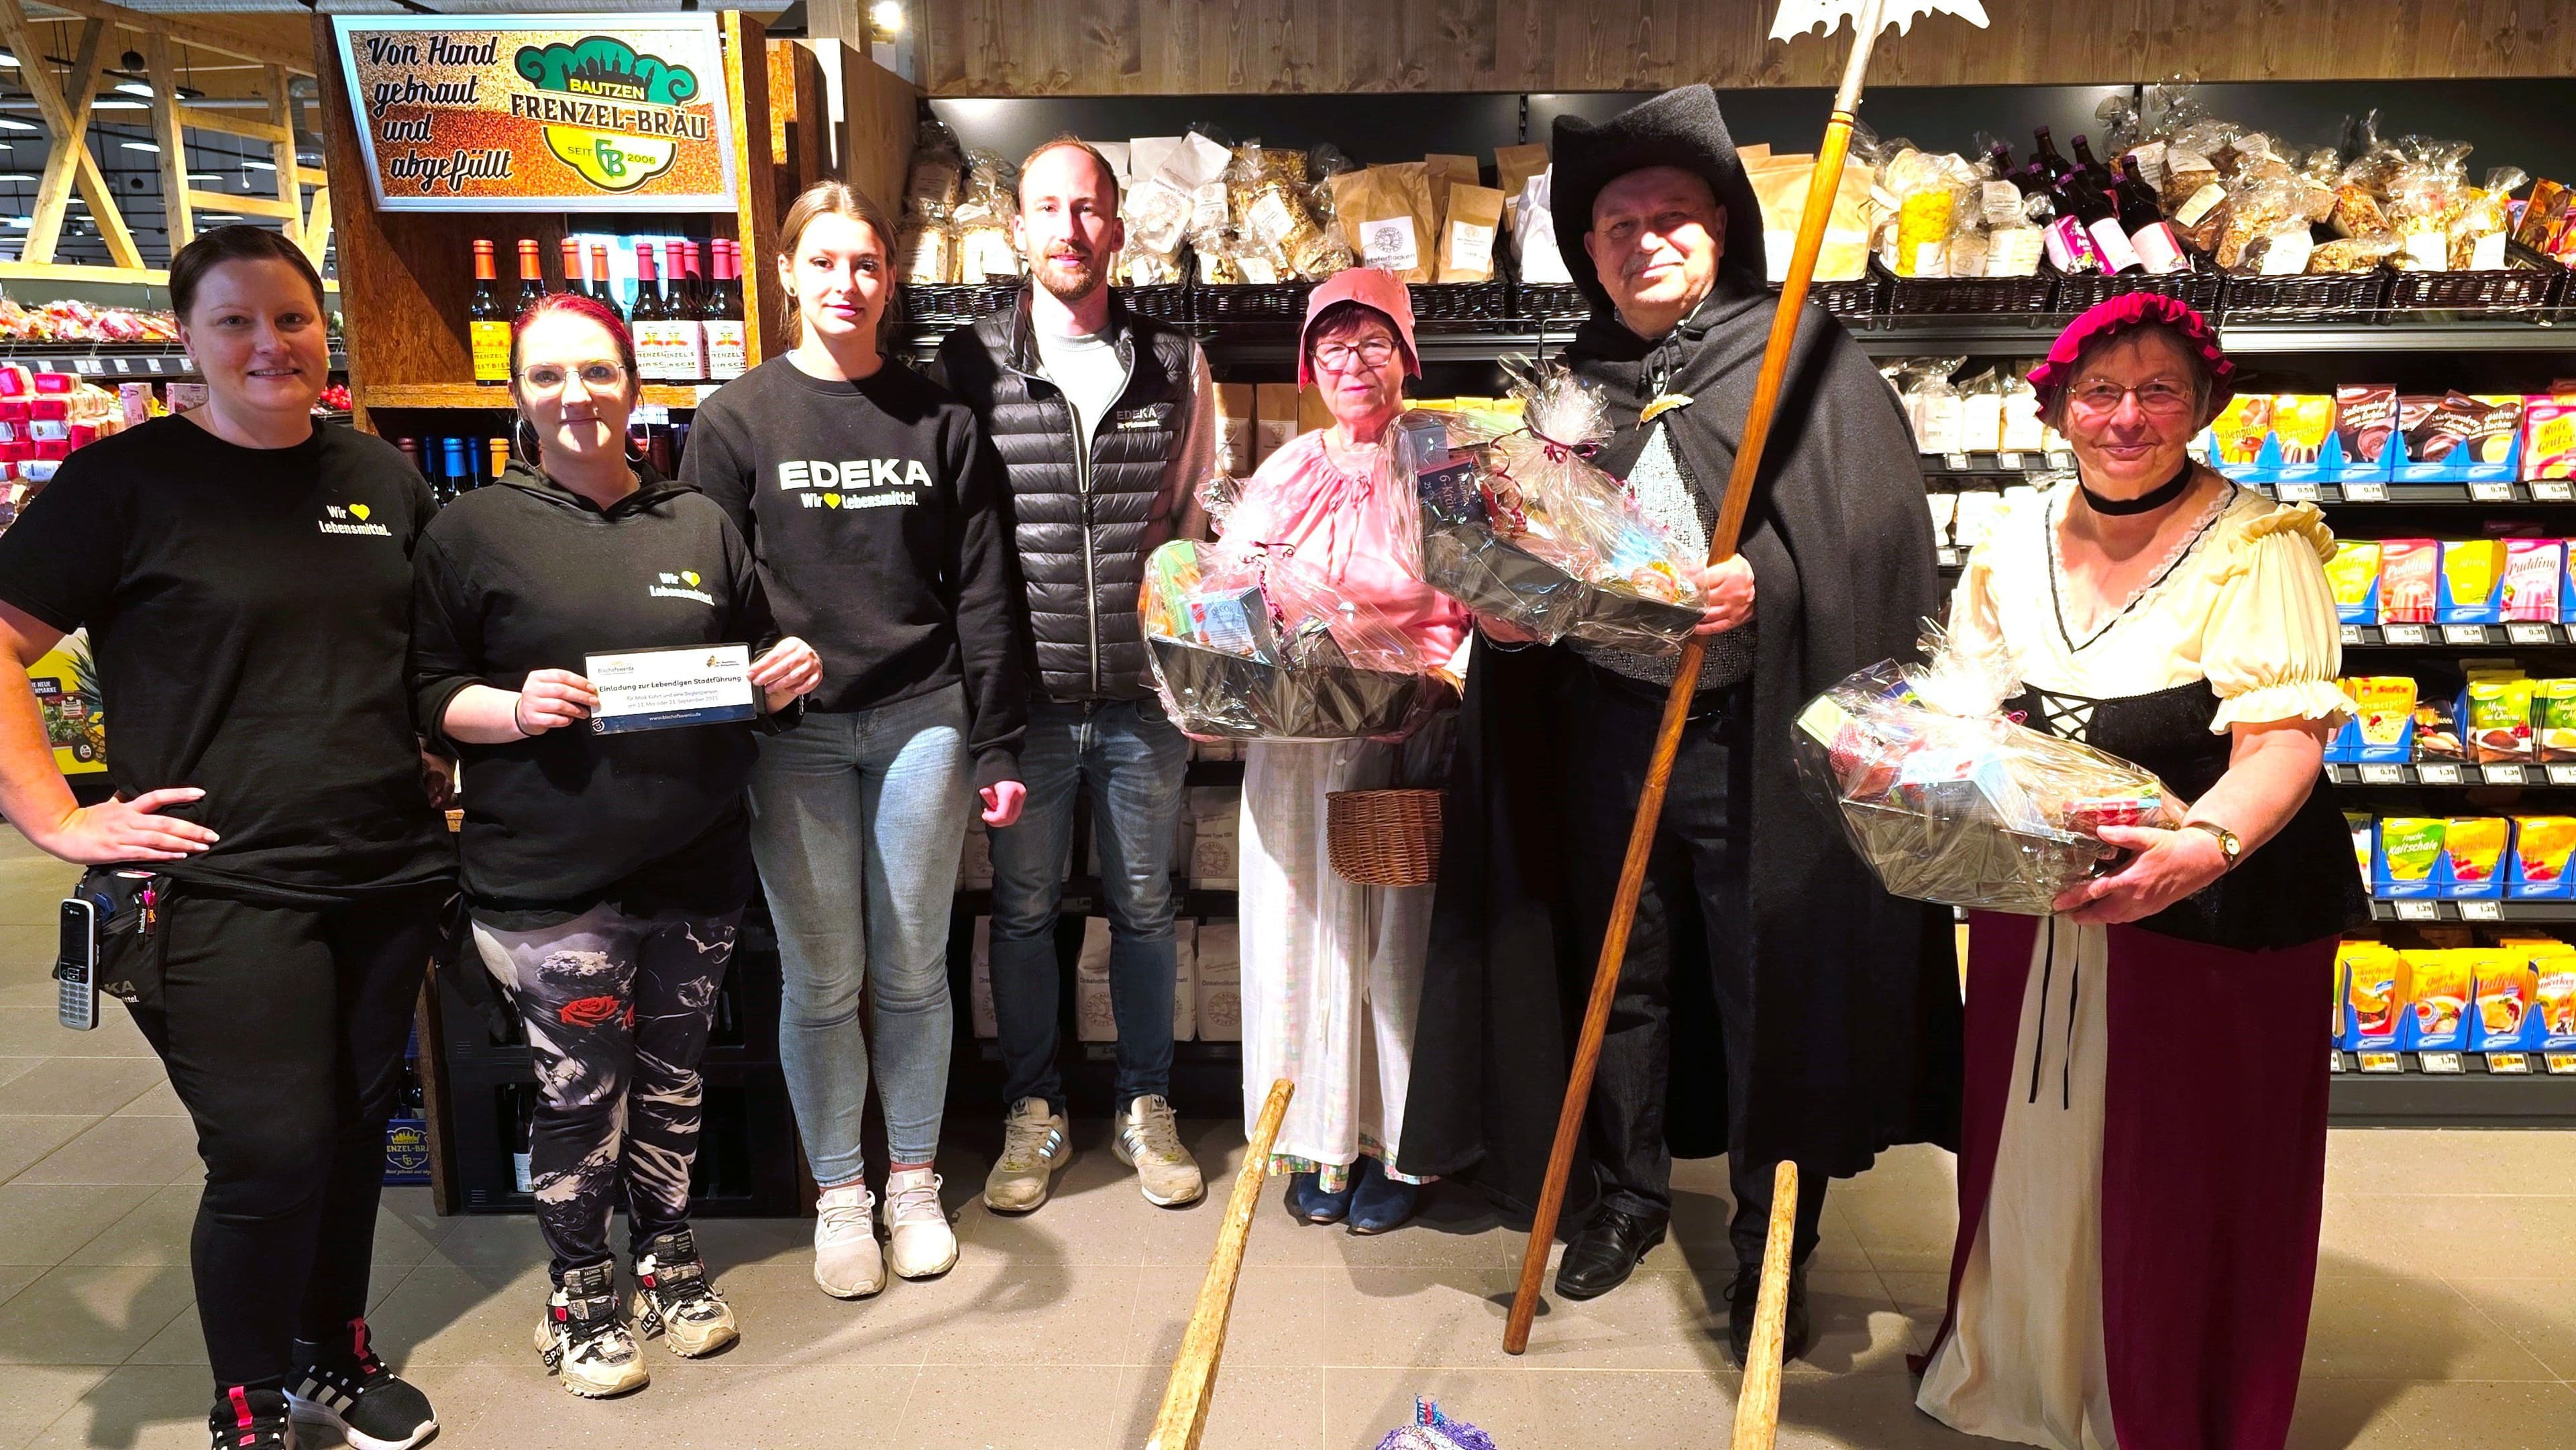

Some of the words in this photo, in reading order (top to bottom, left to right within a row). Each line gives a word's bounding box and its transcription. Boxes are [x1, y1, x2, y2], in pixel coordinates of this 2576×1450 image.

[367, 36, 419, 66] Von
[429, 36, 498, 67] Hand
[373, 74, 480, 117] gebraut
[570, 78, 645, 100] BAUTZEN
[510, 93, 708, 140] FRENZEL-BRÄU
[382, 113, 432, 142] und
[568, 146, 592, 157] SEIT
[627, 154, 656, 165] 2006
[391, 141, 512, 192] abgefüllt
[1366, 253, 1415, 266] Haferflocken
[1116, 407, 1157, 421] EDEKA
[777, 459, 932, 490] EDEKA
[801, 493, 823, 508] Wir
[841, 491, 918, 510] Lebensmittel.
[326, 505, 347, 519] Wir
[318, 520, 392, 537] Lebensmittel.
[2510, 556, 2557, 576] Pudding
[659, 572, 680, 585] Wir
[599, 683, 637, 693] Einladung
[651, 679, 693, 689] Lebendigen
[694, 675, 742, 686] Stadtführung
[2402, 831, 2426, 842] Frucht-
[2387, 839, 2438, 856] Kaltschale
